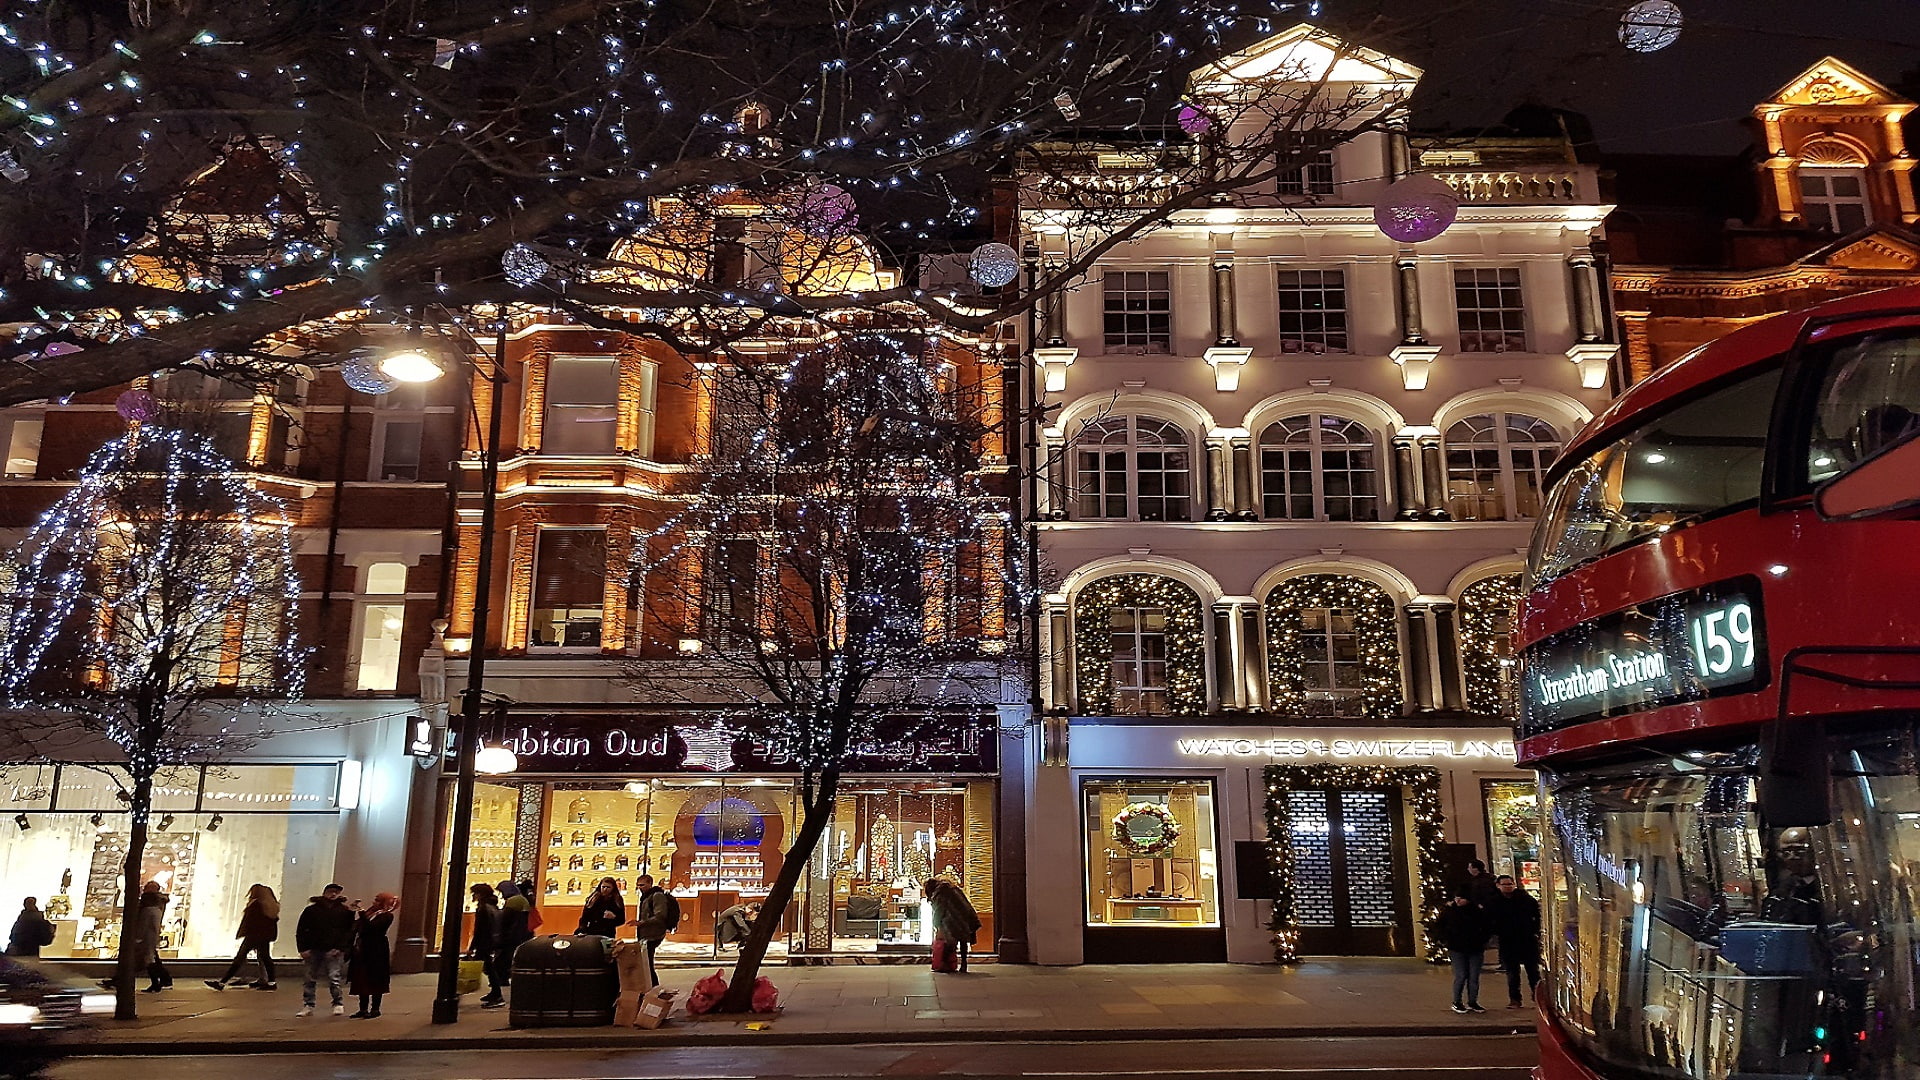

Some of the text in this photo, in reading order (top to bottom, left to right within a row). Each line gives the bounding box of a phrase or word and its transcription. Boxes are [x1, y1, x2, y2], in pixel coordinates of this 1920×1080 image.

[1692, 603, 1755, 677] 159
[1539, 651, 1666, 706] Streatham Station
[477, 728, 668, 756] abian Oud
[1178, 739, 1308, 756] WATCHES
[1333, 739, 1515, 756] SWITZERLAND
